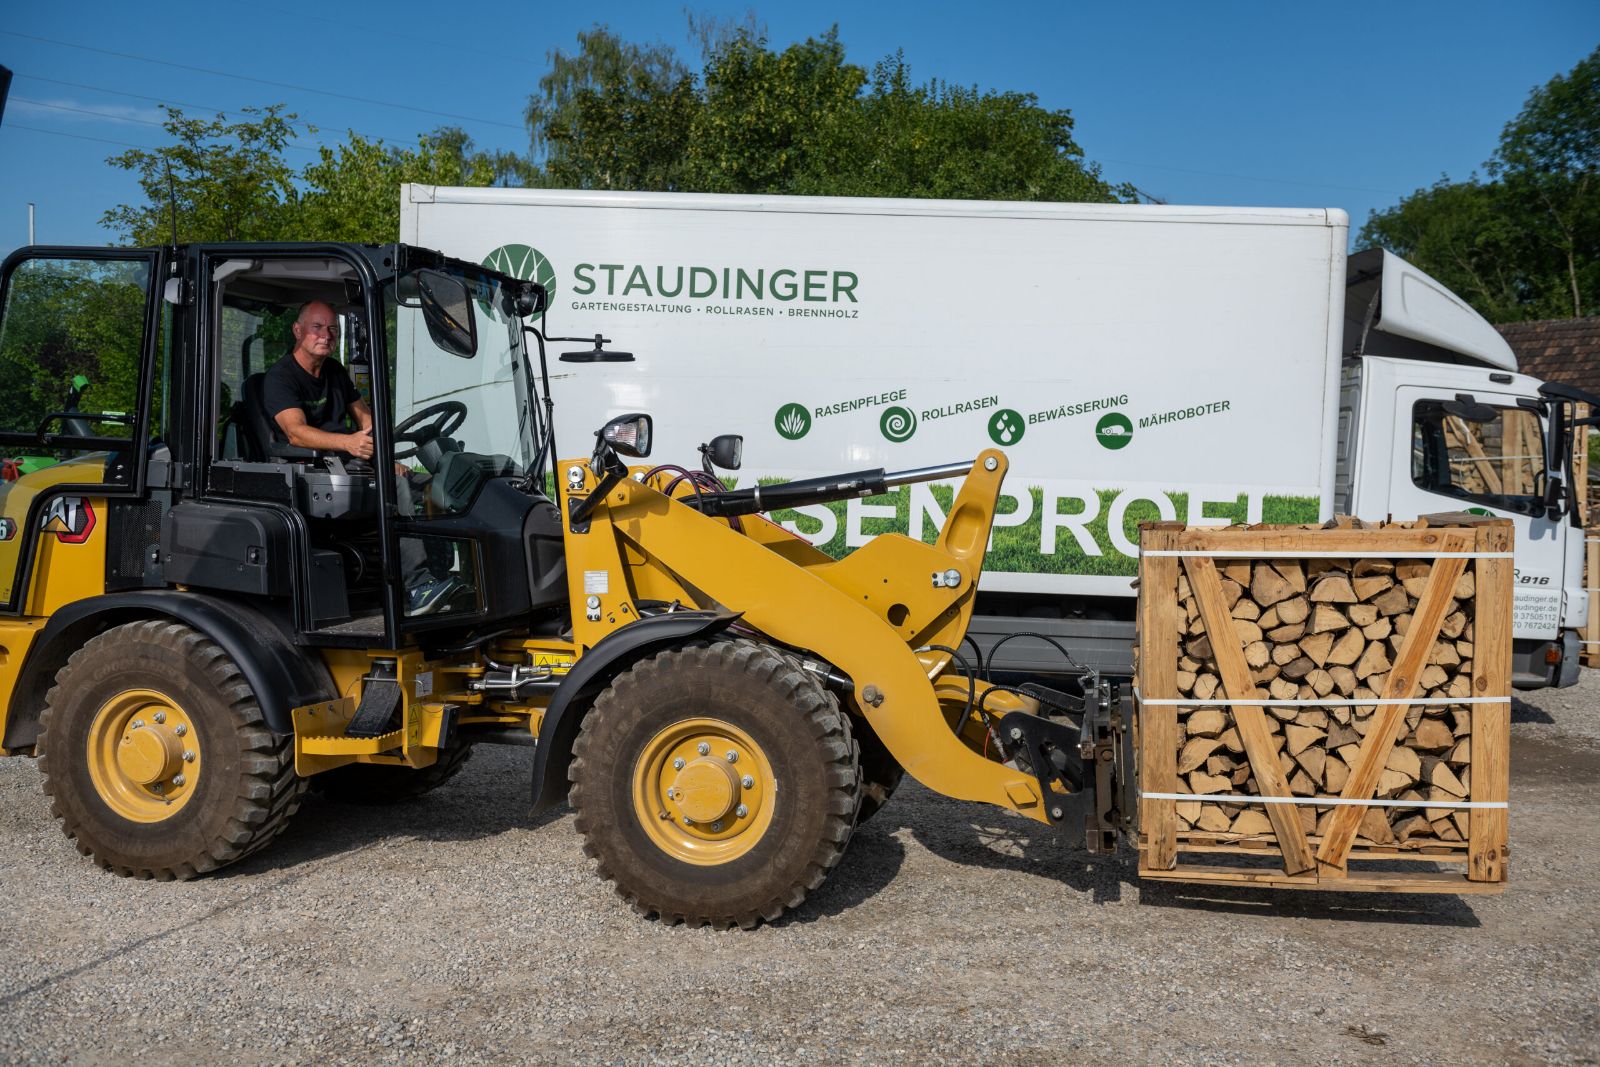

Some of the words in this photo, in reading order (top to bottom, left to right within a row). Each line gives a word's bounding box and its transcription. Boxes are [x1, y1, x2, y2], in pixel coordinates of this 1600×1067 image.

[572, 263, 859, 303] STAUDINGER
[571, 301, 692, 314] GARTENGESTALTUNG
[705, 305, 774, 317] ROLLRASEN
[788, 308, 859, 319] BRENNHOLZ
[815, 389, 907, 418] RASENPFLEGE
[921, 395, 999, 422] ROLLRASEN
[1028, 394, 1129, 425] BEWÄSSERUNG
[1139, 400, 1231, 429] MÄHROBOTER
[41, 496, 82, 533] AT
[1520, 575, 1550, 585] 816
[1513, 604, 1557, 612] audinger.de
[1514, 595, 1558, 603] audinger.de
